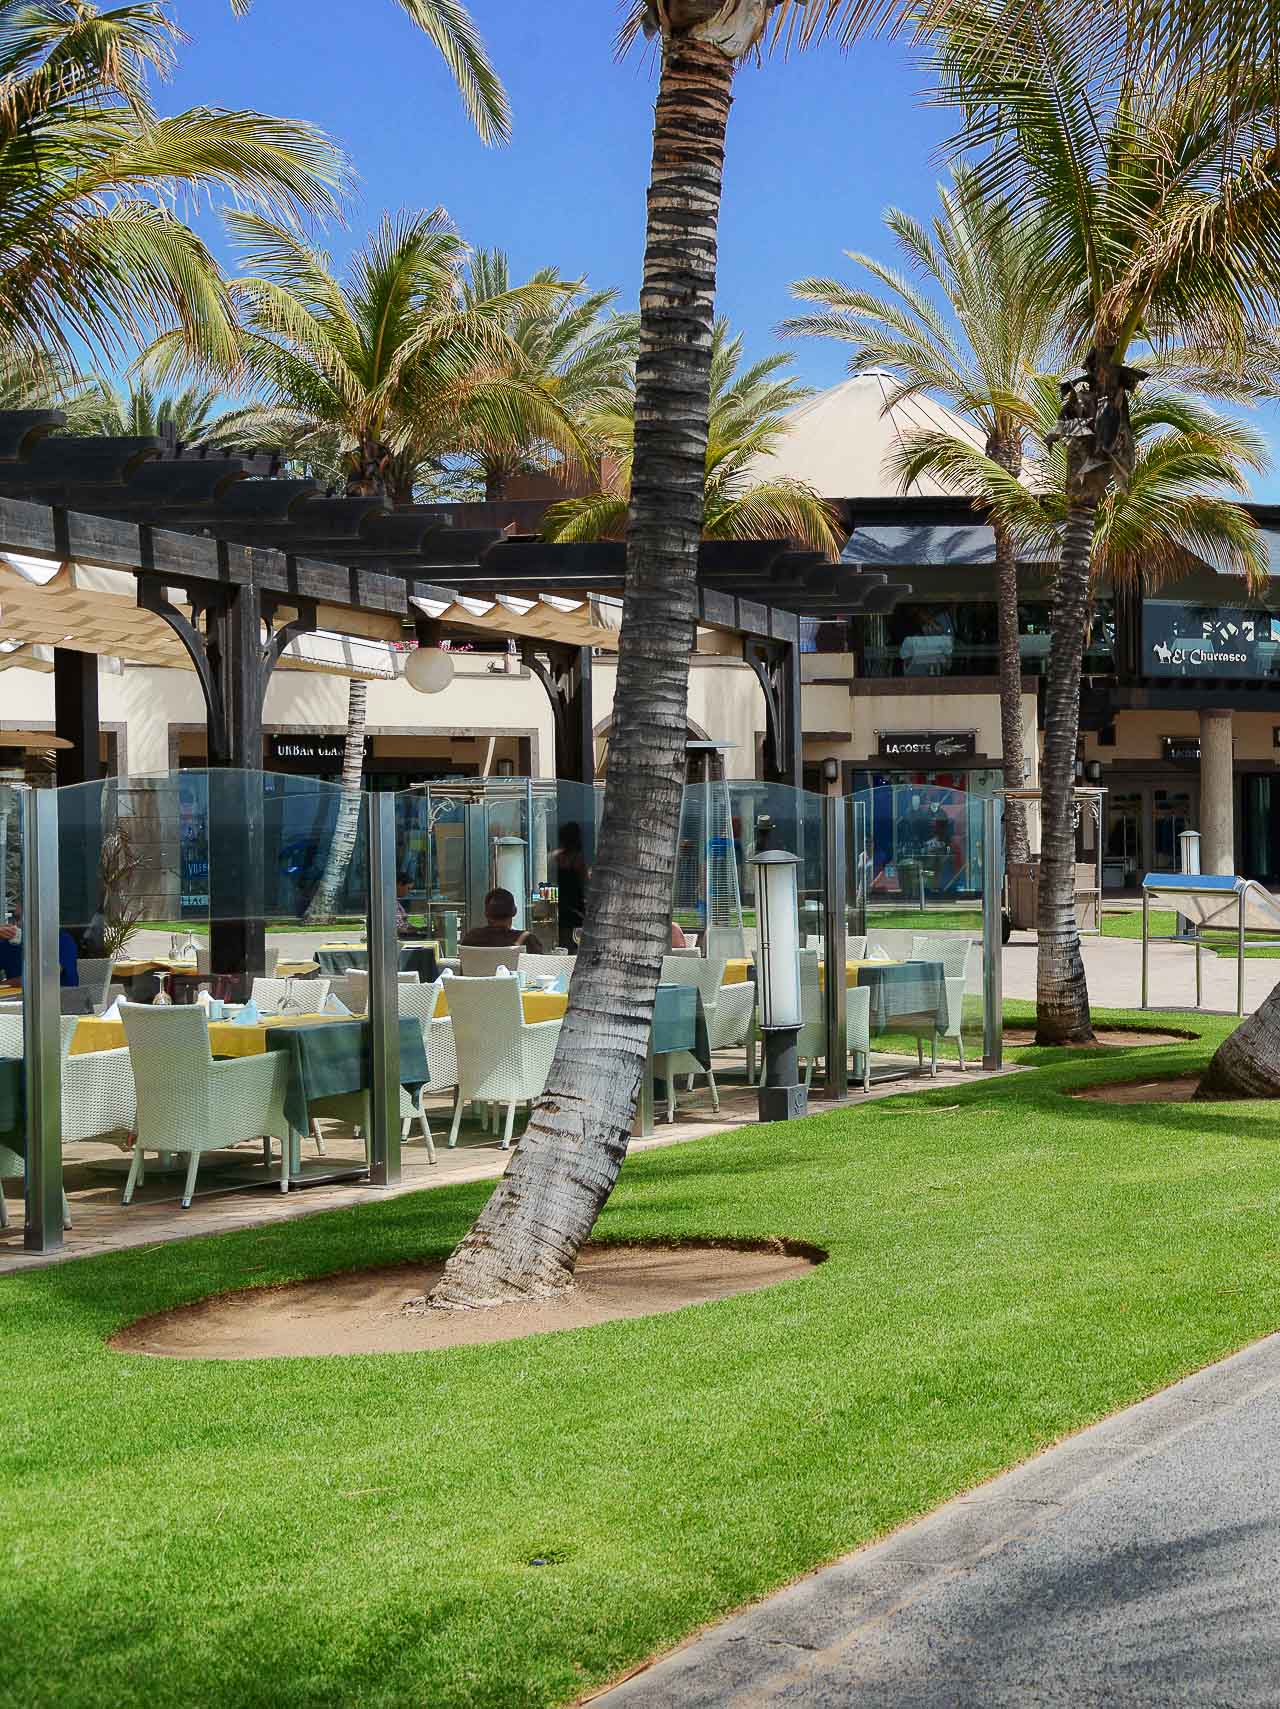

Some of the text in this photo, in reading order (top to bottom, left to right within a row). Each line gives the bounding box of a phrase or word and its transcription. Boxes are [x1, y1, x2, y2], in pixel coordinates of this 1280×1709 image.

[1172, 648, 1247, 665] El Churrasco
[277, 745, 314, 756] URBAN
[886, 743, 932, 753] LACOSTE
